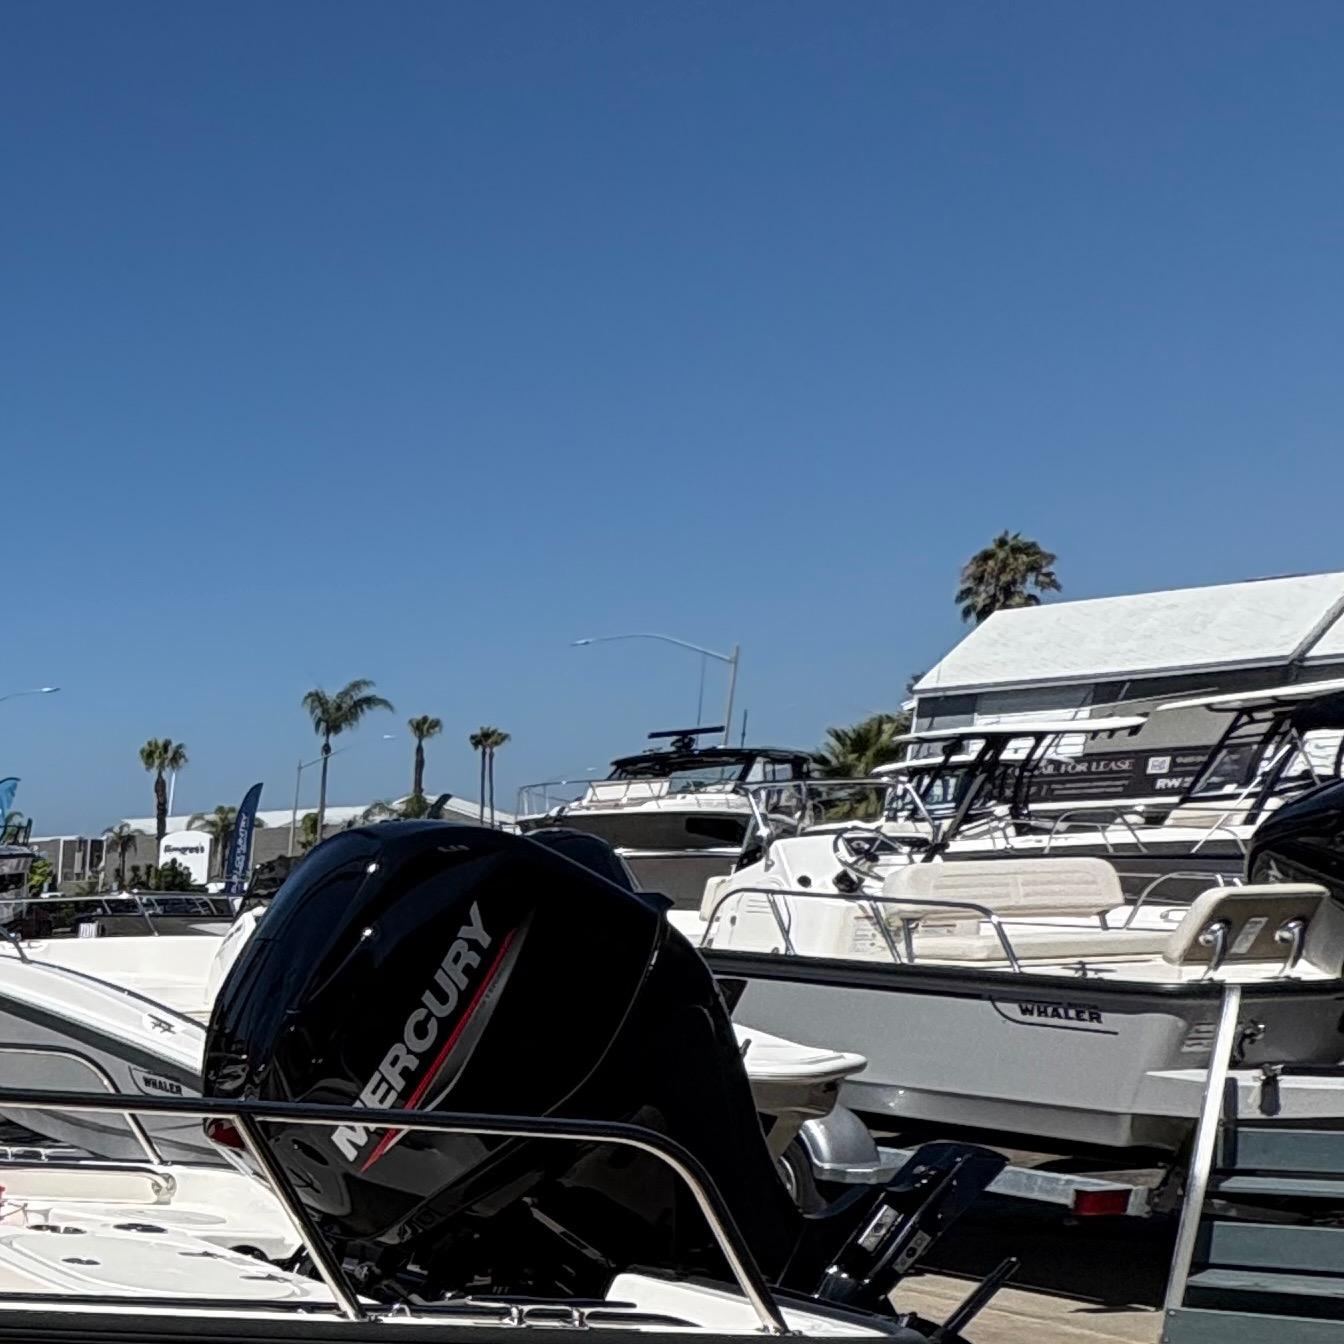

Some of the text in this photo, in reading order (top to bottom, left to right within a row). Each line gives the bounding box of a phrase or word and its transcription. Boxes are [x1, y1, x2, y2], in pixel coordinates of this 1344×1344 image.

[1018, 1004, 1102, 1023] WHALER
[331, 900, 493, 1162] MERCURY
[143, 1076, 183, 1095] WHALER
